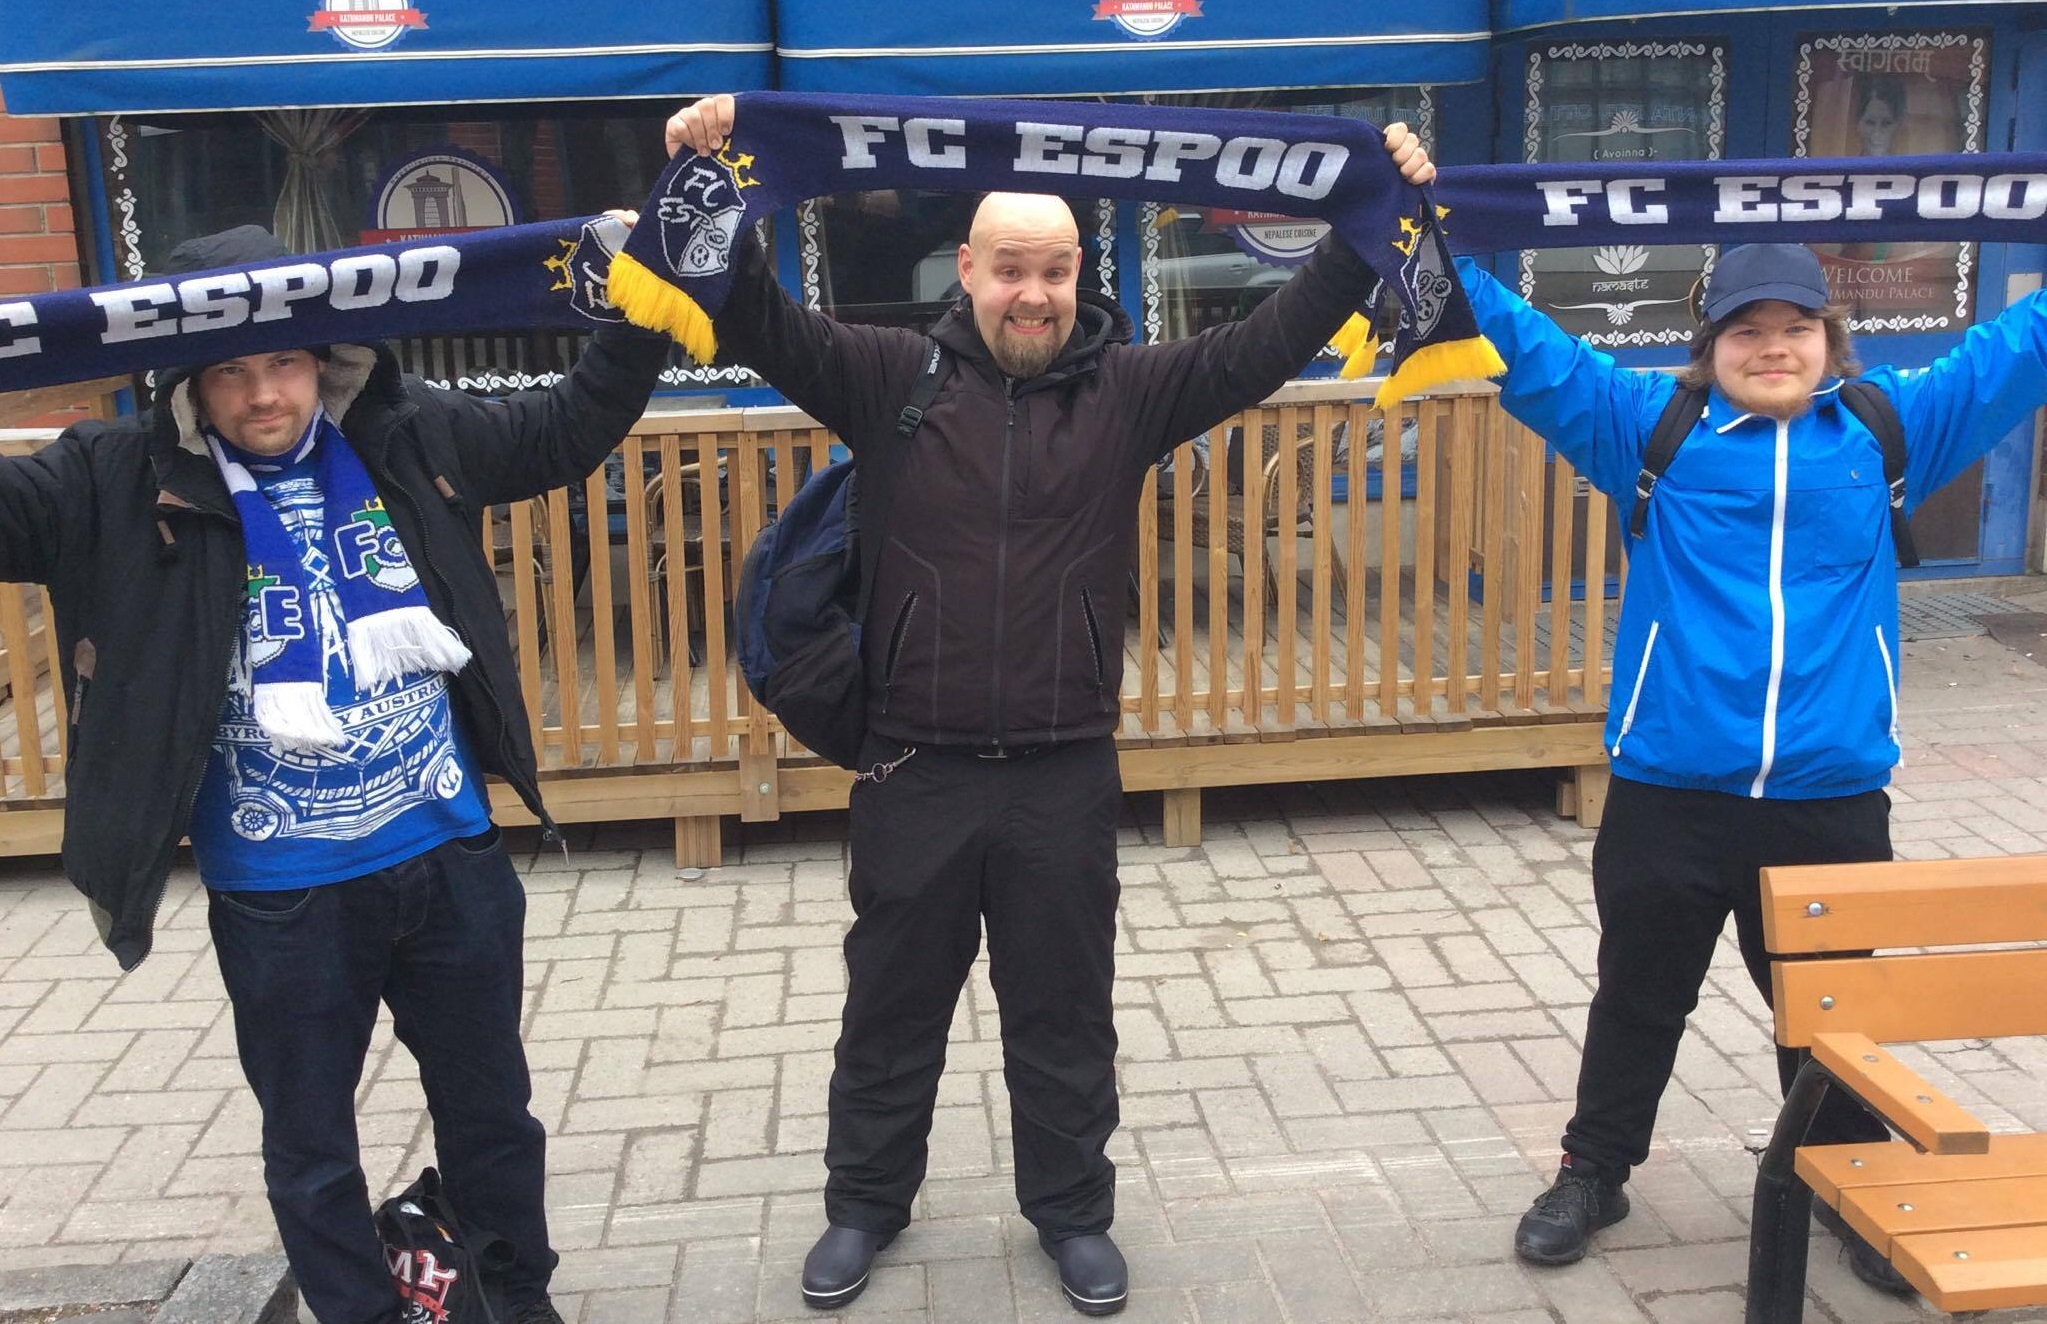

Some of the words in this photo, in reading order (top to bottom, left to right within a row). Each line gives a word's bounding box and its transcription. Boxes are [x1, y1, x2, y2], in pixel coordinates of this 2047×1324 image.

[829, 115, 966, 169] FC
[1013, 121, 1349, 200] ESPOO
[1536, 178, 1668, 226] FC
[1713, 173, 2047, 223] ESPOO
[1264, 229, 1293, 239] NEPALESE
[1294, 228, 1317, 238] CUISINE
[1820, 266, 1914, 284] WELCOME
[89, 246, 461, 344] ESPOO
[1889, 287, 1936, 299] PALACE
